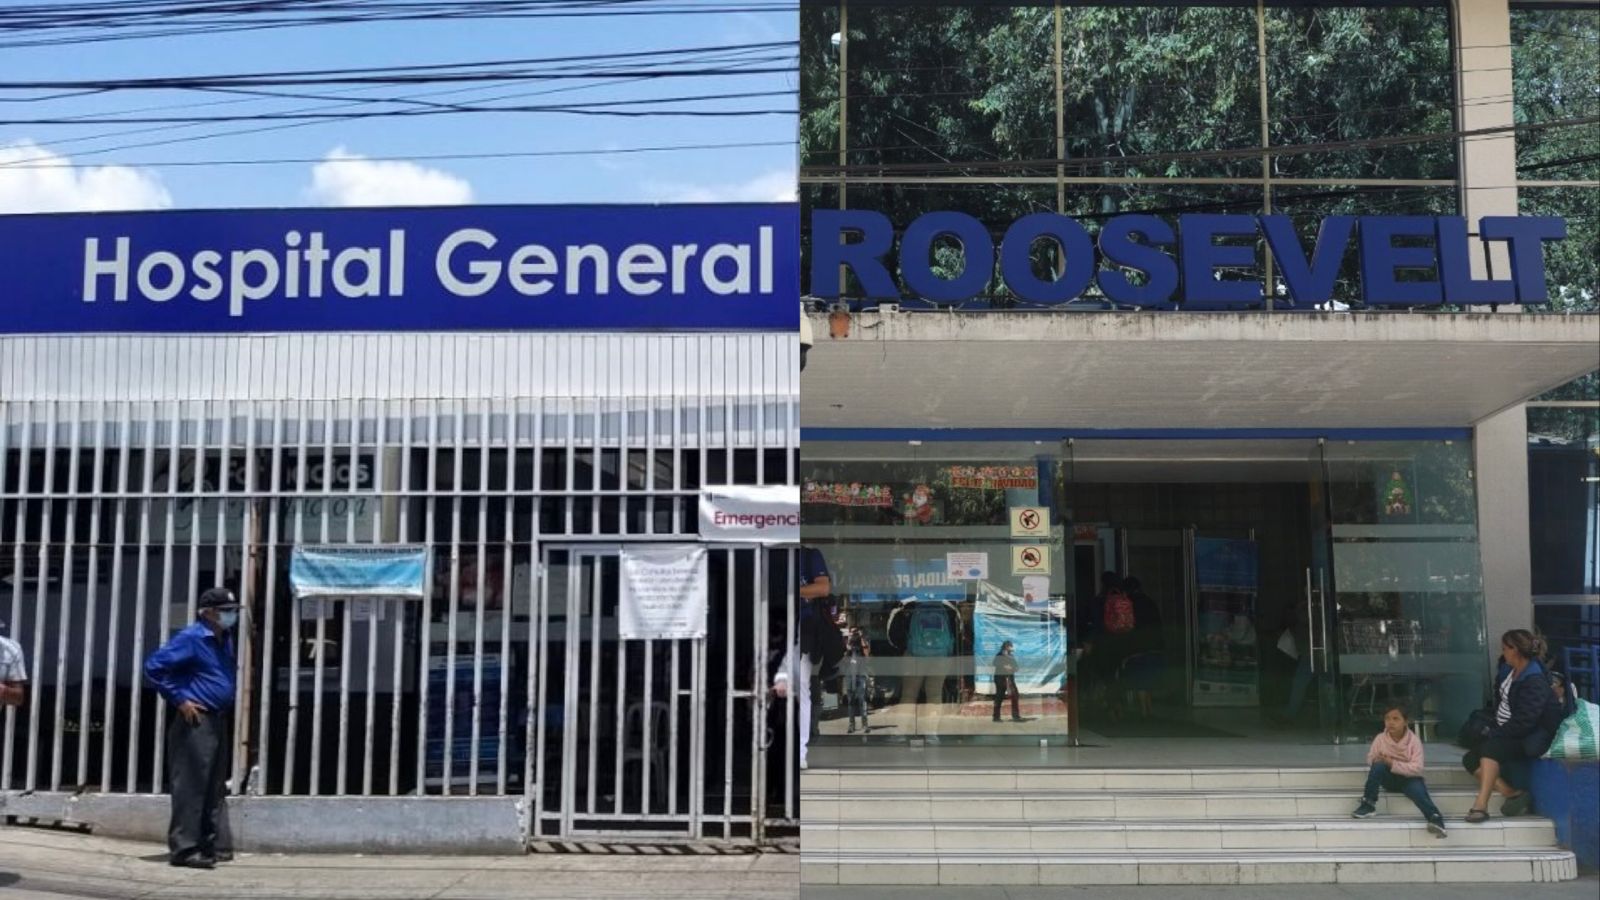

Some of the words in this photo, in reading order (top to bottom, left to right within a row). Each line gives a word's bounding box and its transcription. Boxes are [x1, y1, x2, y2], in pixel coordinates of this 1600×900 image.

[83, 229, 405, 317] Hospital
[435, 226, 774, 297] General
[811, 208, 1567, 304] ROOSEVELT
